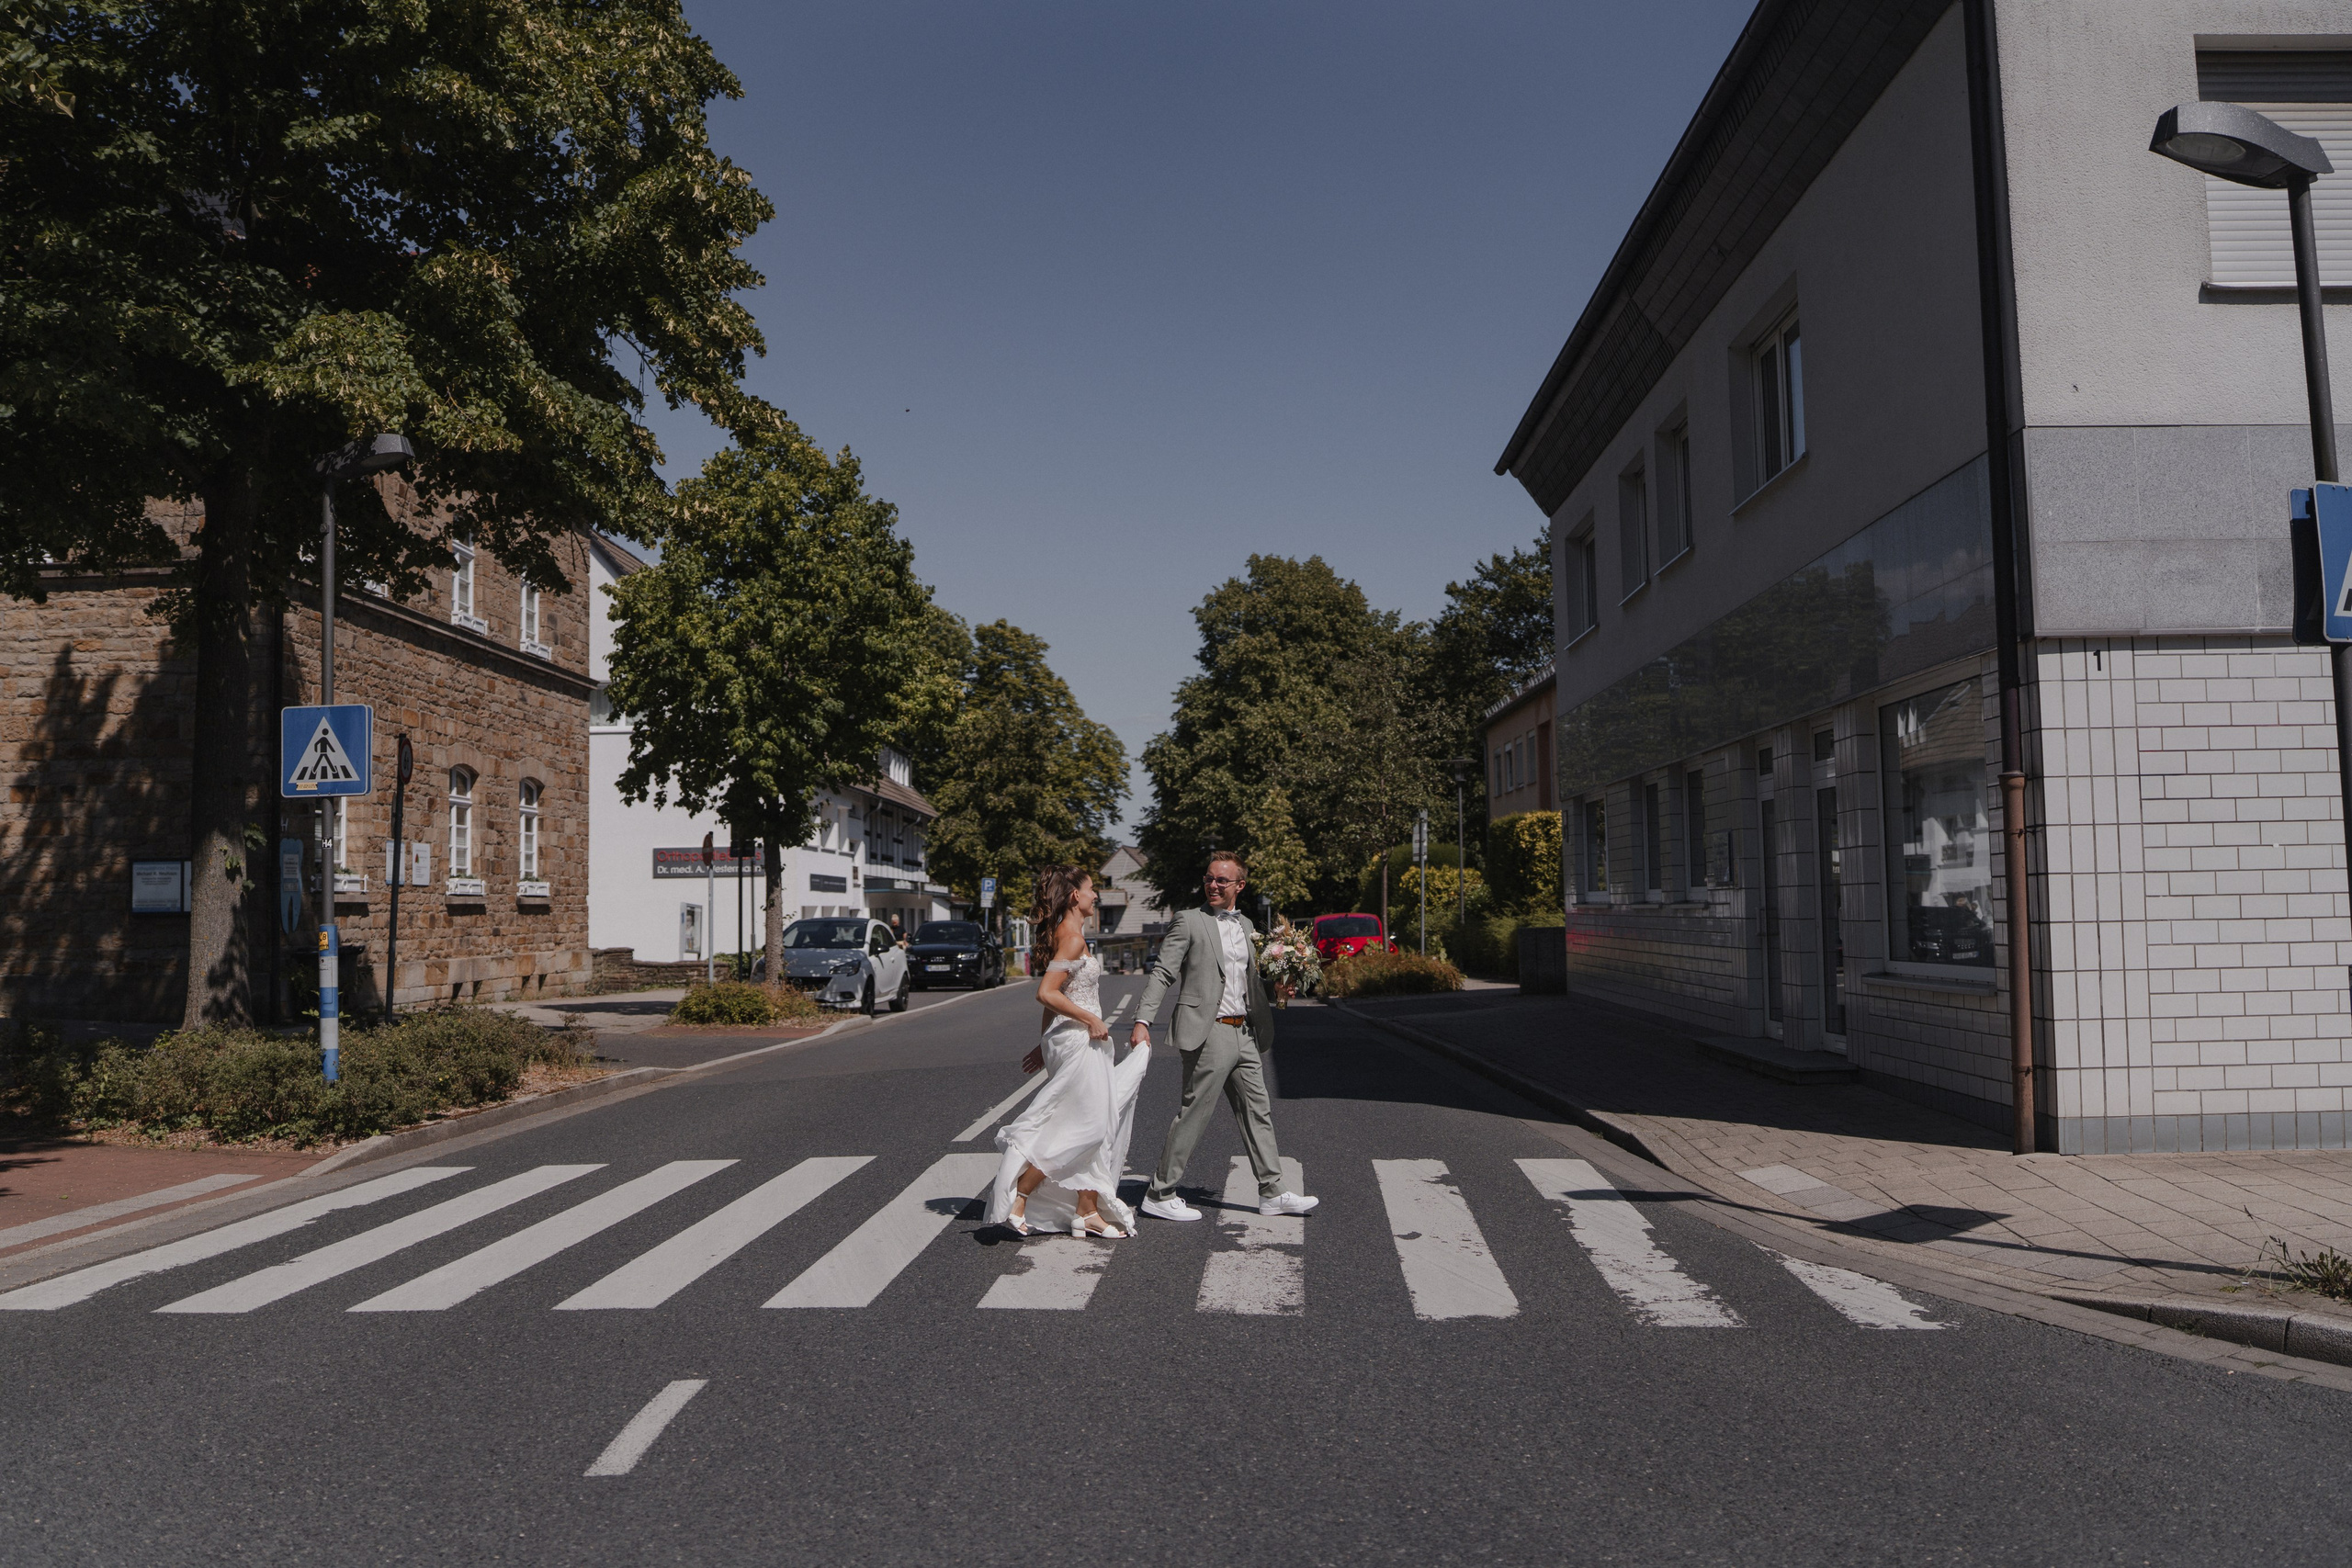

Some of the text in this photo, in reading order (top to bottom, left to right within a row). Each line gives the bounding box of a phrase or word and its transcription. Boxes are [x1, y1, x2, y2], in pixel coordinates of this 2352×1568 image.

[2093, 649, 2102, 671] 1
[657, 850, 762, 863] Orthopdieps
[657, 864, 762, 874] Dr. med. A. esterman
